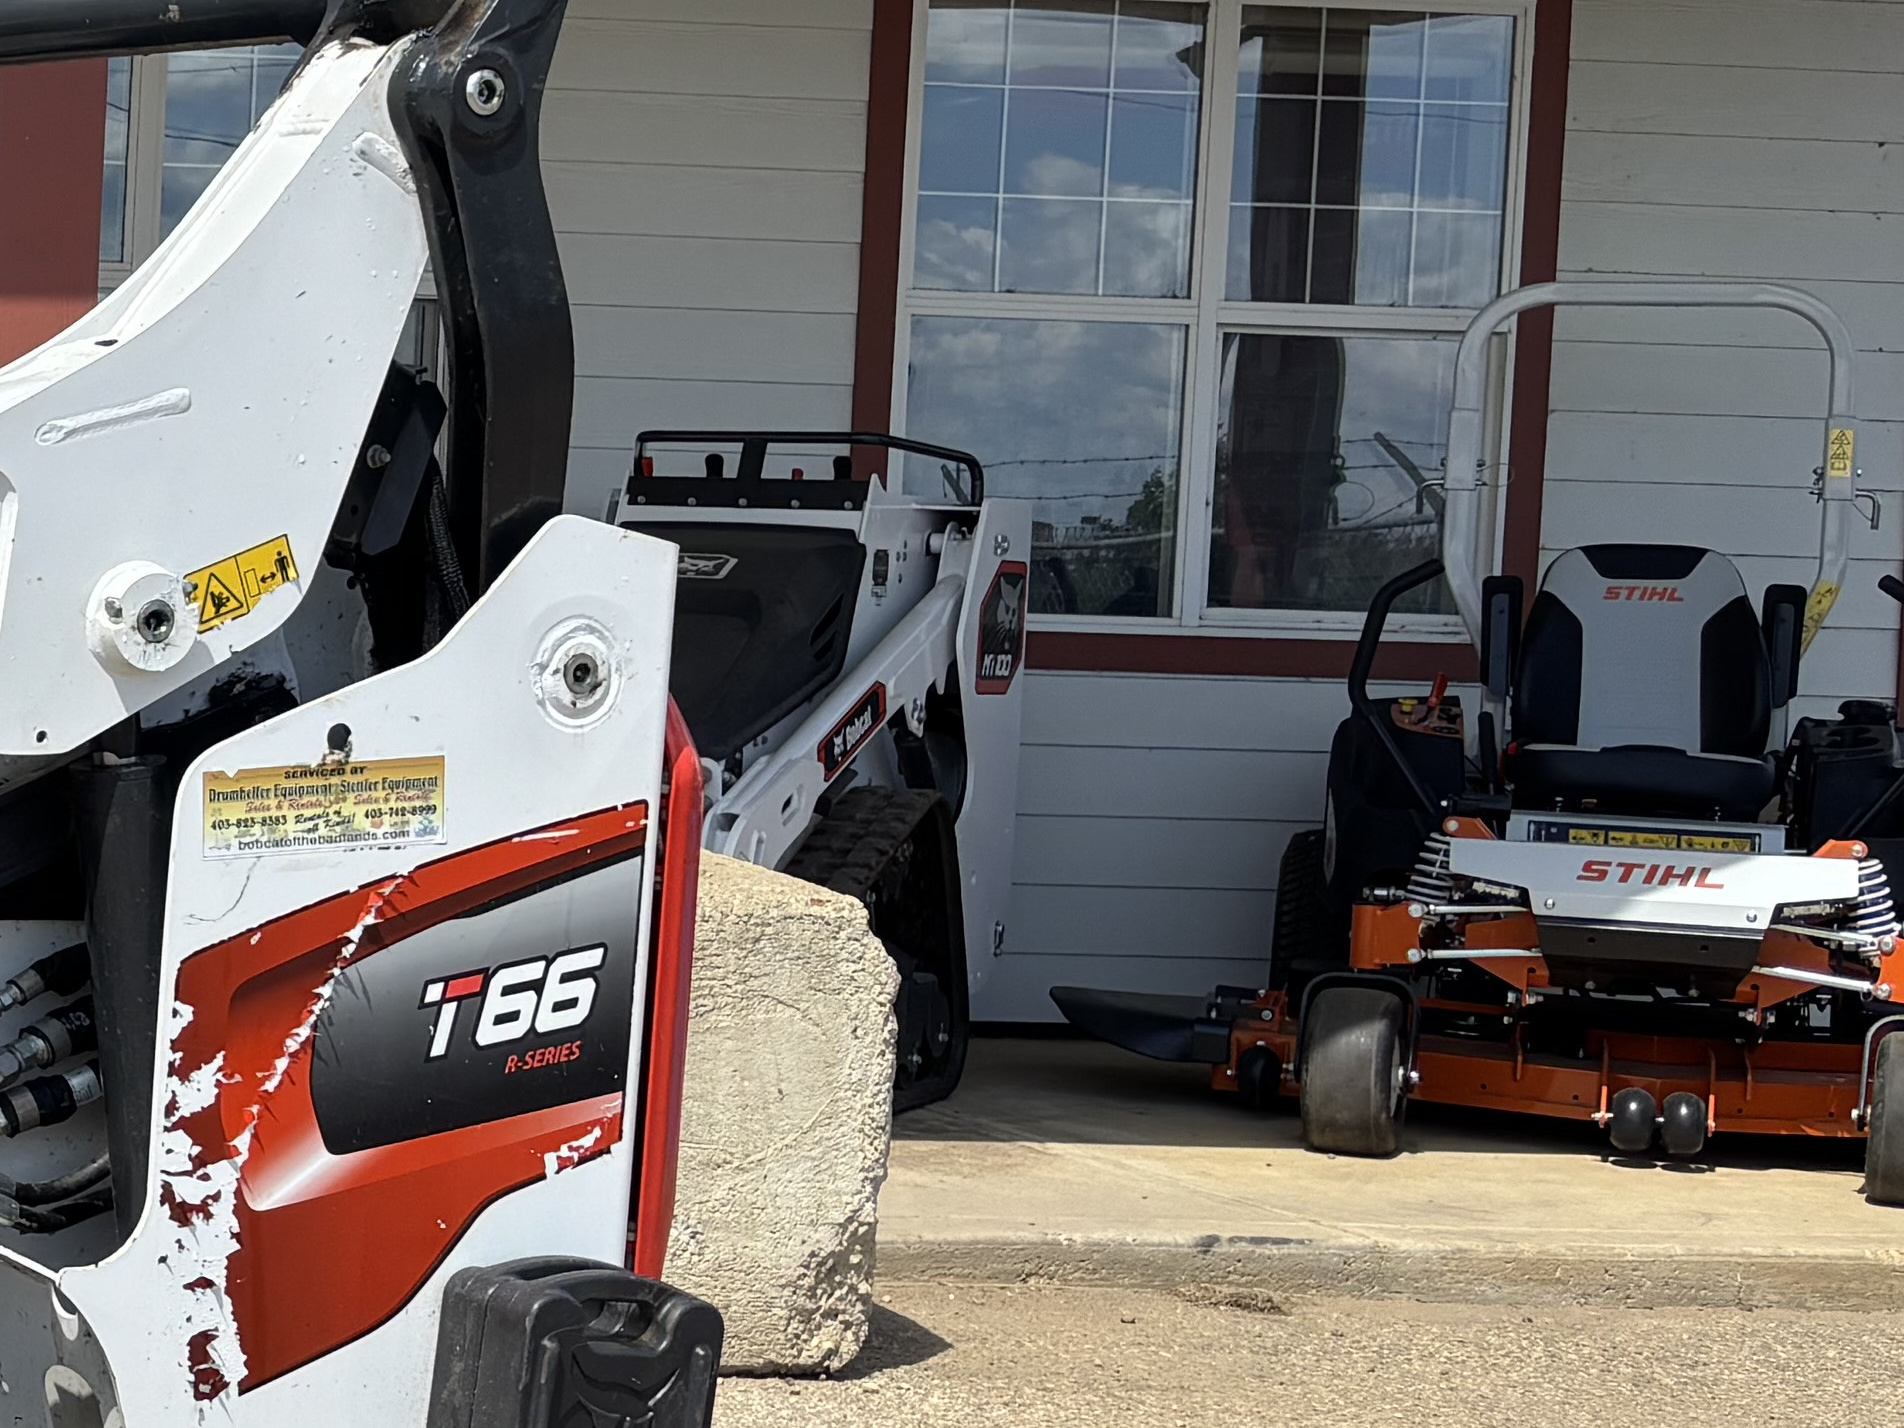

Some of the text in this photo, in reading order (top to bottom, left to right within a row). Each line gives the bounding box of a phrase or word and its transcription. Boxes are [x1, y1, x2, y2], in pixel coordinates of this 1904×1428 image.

[1603, 585, 1685, 603] STIHL
[273, 782, 332, 800] Equipment
[381, 775, 438, 793] Equipment
[1576, 859, 1724, 889] STIHL
[420, 945, 607, 1060] T66
[505, 1040, 583, 1074] R-SERIES
